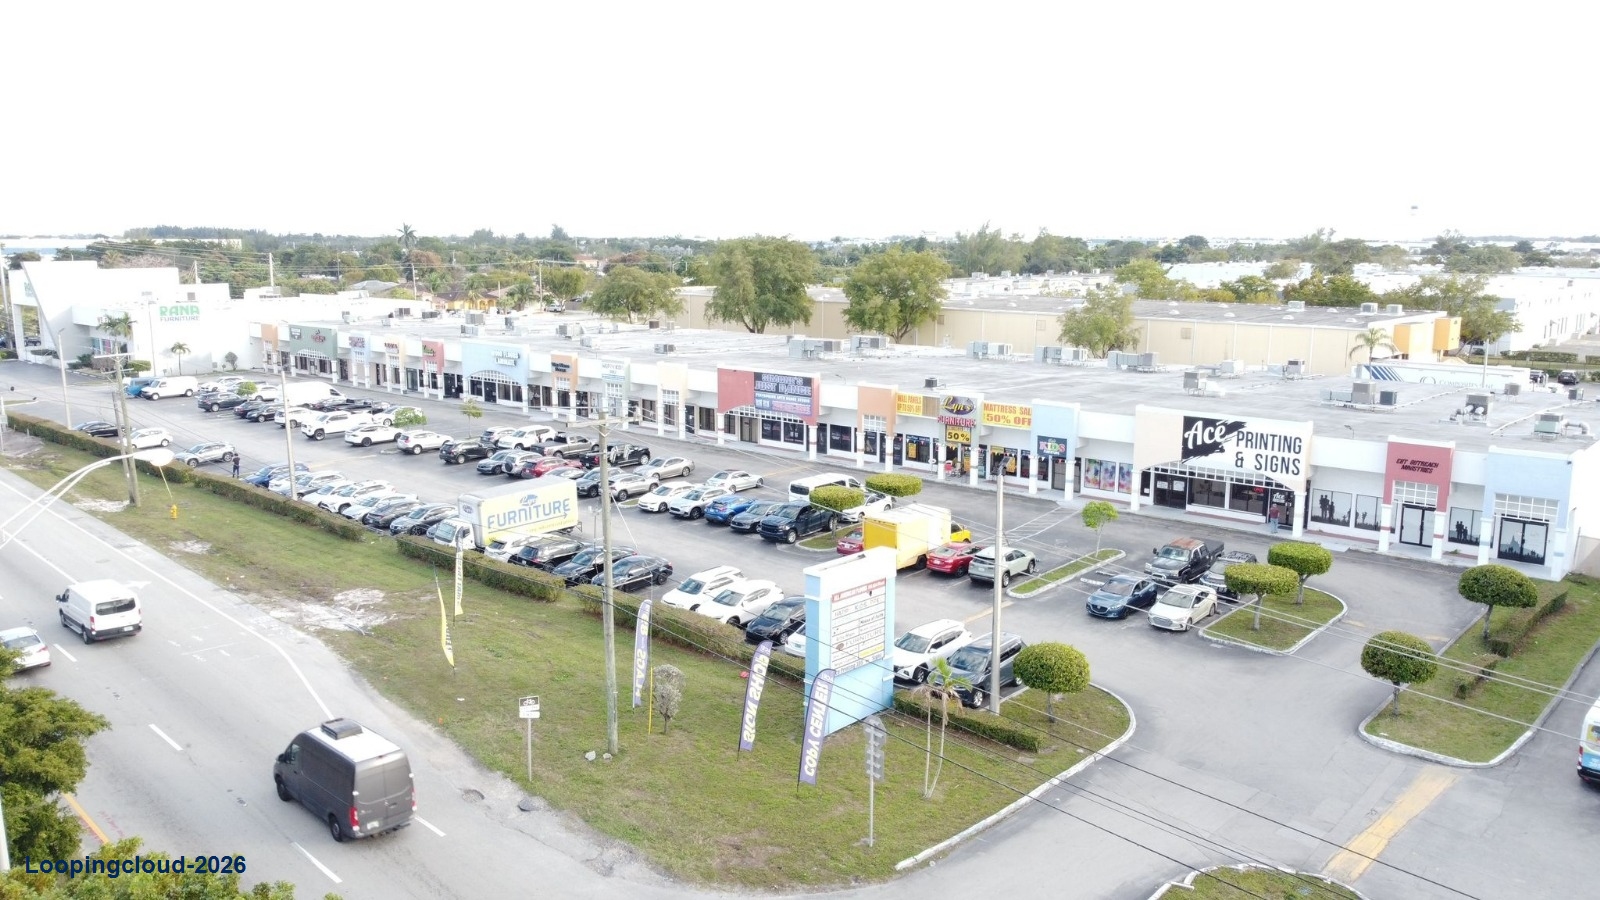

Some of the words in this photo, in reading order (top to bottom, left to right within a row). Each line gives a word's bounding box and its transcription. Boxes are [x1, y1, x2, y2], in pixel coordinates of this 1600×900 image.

[159, 305, 200, 316] RANA
[755, 380, 777, 392] JUST
[778, 384, 812, 395] DANCE
[983, 402, 1016, 414] MATTRESS
[937, 415, 976, 428] FURNITURE
[986, 413, 1011, 424] 50%
[1039, 441, 1066, 453] KIDS
[1236, 430, 1302, 455] PRINTING
[1235, 451, 1245, 468] &
[1254, 453, 1301, 476] SIGNS
[1401, 464, 1434, 474] MINISTRIES
[1410, 460, 1440, 468] OUTREACH
[487, 498, 571, 529] FURNITURE
[845, 629, 883, 647] FURNITURE
